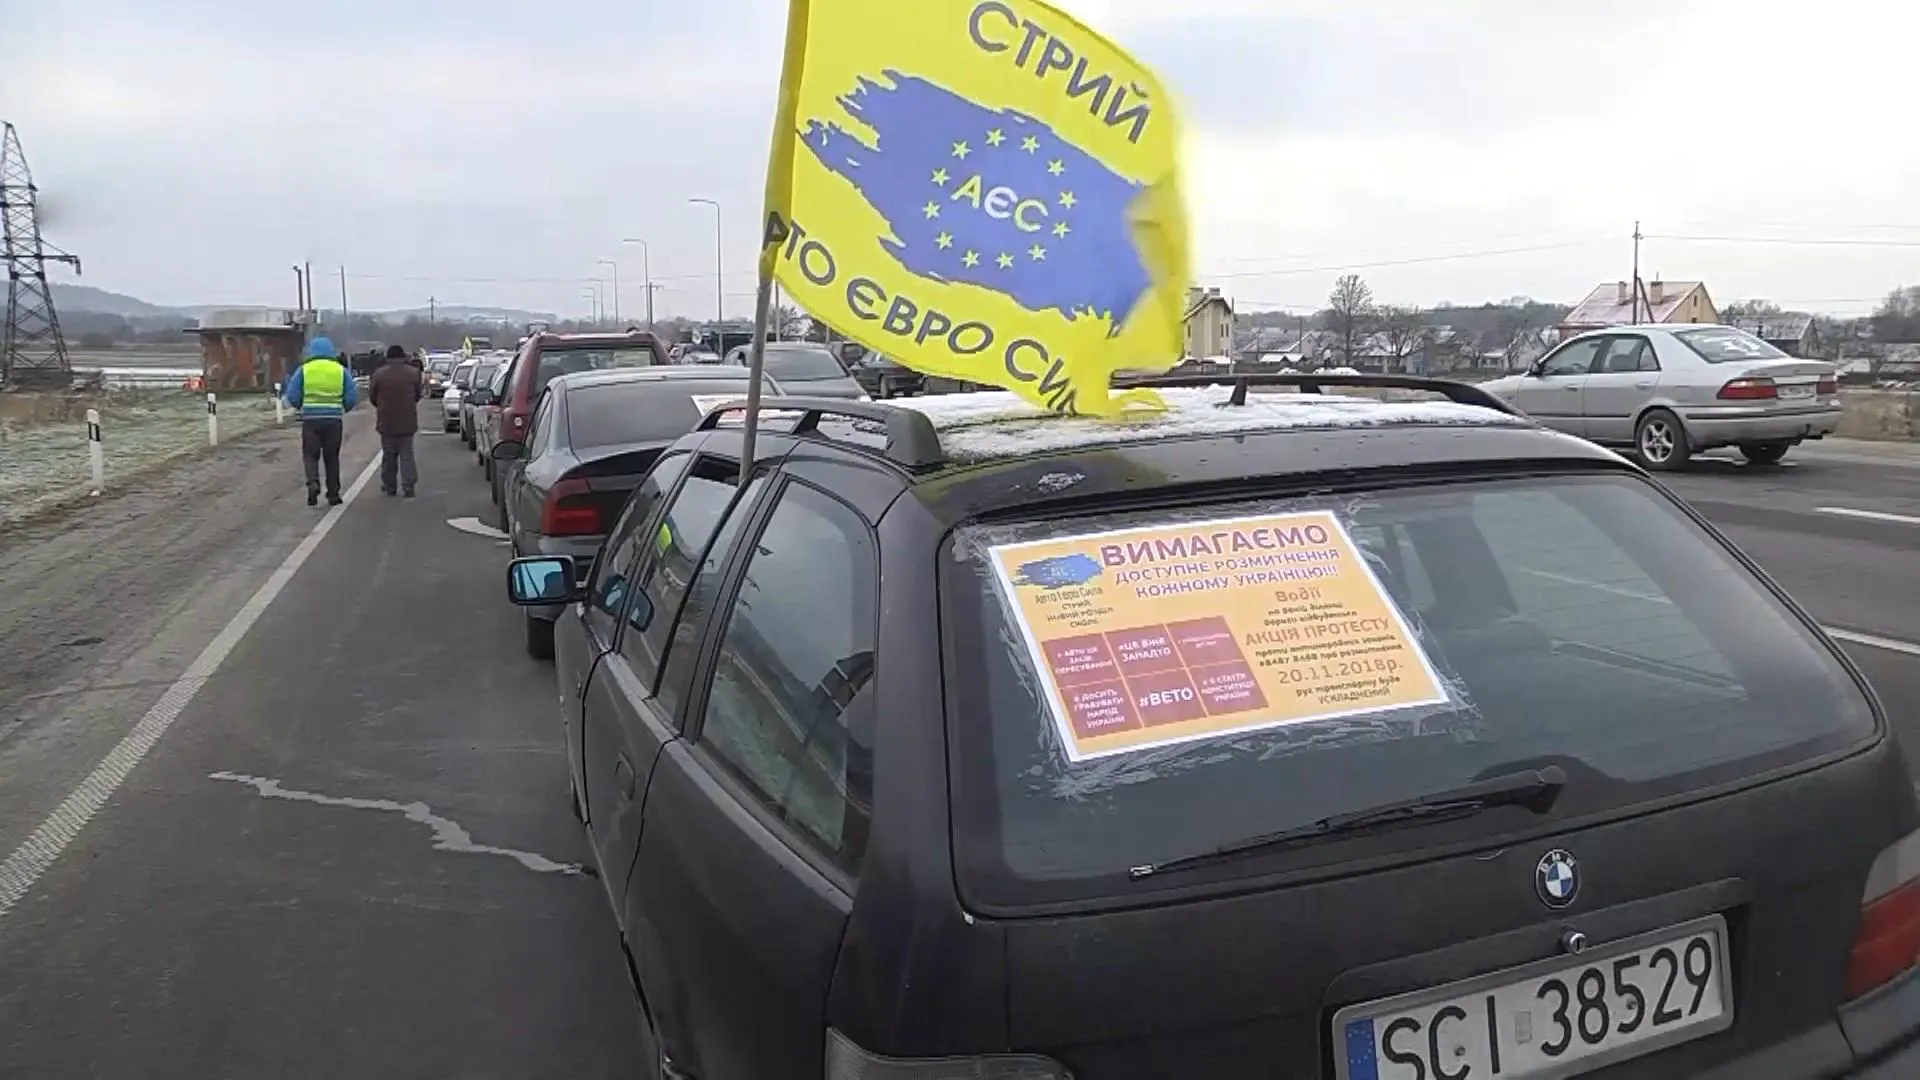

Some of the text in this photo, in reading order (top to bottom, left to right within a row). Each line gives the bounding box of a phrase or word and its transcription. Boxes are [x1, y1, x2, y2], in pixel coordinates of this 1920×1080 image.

[969, 1, 1152, 145] СТРИЙ
[951, 175, 1048, 232] АЄС
[846, 278, 994, 355] ЄВРО
[1100, 525, 1328, 566] ВИМАГАЄМО
[1115, 550, 1339, 585] ДОСТУПНЕ РОЗМИТНЕННЯ
[1136, 565, 1338, 599] КОЖНОМУ УКРАЇНЦЮ!!!
[1275, 587, 1321, 603] Водії
[1245, 628, 1300, 646] АКЦІЯ
[1304, 617, 1389, 639] ПРОТЕСТУ
[1122, 647, 1171, 662] ЗАНАДТО
[1278, 659, 1404, 684] 20.11.2018р.
[1138, 687, 1194, 707] #ВЕТО
[1382, 937, 1713, 1080] SCI 38529
